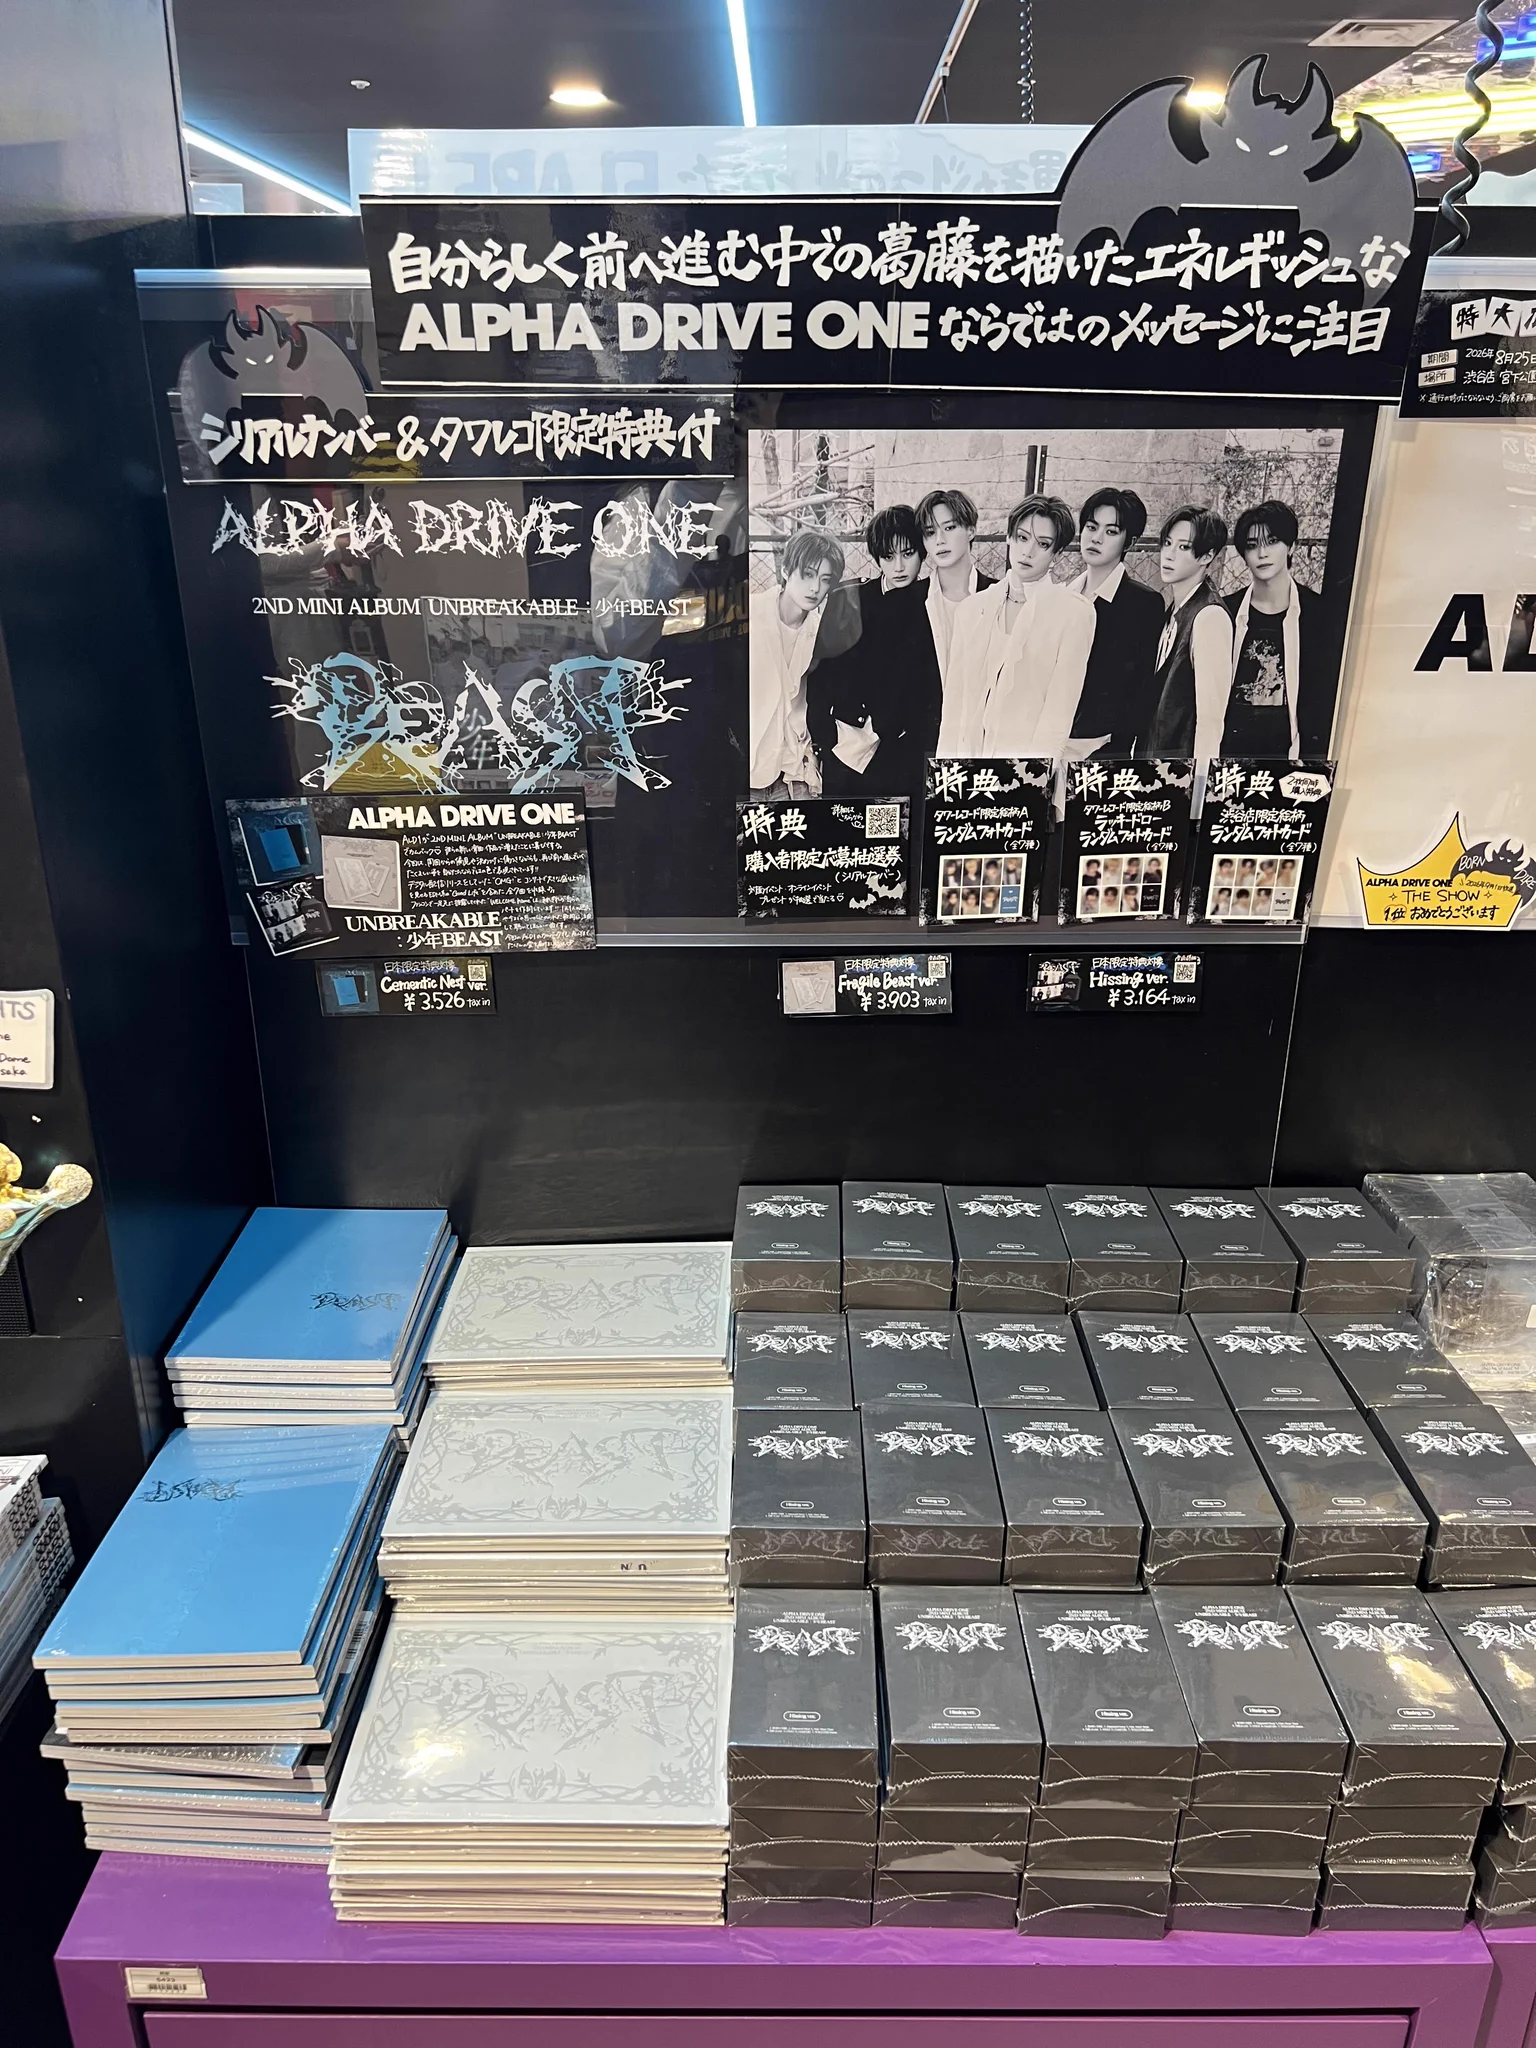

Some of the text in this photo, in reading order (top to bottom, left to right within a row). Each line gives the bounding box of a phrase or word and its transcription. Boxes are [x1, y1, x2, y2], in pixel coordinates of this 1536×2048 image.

[388, 217, 1410, 293] 自分らしく前へ進む中での葛藤を描いたエネルギッシュな
[400, 301, 1391, 357] ALPHA DRIVE ONE ならではのメッセージに注目
[1427, 352, 1449, 364] 期間
[1423, 371, 1447, 383] 場所
[1463, 369, 1495, 384] 渋谷店
[200, 408, 720, 465] シリアルナンバー&タワレコ限定特典付
[210, 496, 724, 560] ALPHA DRIVE ONE
[252, 598, 294, 616] 2ND
[297, 598, 344, 616] MINI
[347, 598, 421, 616] ALBUM
[428, 598, 578, 616] UNBREAKABLE
[595, 598, 691, 619] 少年BEAST
[934, 762, 999, 802] 特典
[1074, 762, 1140, 802] 特典
[1213, 763, 1274, 801] 特典
[348, 803, 575, 829] ALPHA DRIVE ONE
[742, 804, 807, 844] 特典
[1094, 813, 1162, 831] ラッキードロー
[1218, 807, 1305, 823] 渋谷店限定絵柄
[934, 820, 1033, 845] ランダムフォトカード
[1079, 825, 1172, 848] ランダムフォトカード
[1210, 823, 1312, 844] ランダムフォトカード
[745, 845, 903, 873] 購入者限定応募抽選券
[1458, 855, 1486, 872] BORN
[1365, 878, 1453, 887] ALPHA DRIVE ONE
[1401, 890, 1480, 904] THE SHOW
[345, 911, 501, 932] UNBREAKABLE
[1383, 905, 1499, 921] 1位 おめでとうございます
[407, 930, 503, 950] 少年BEAST
[381, 974, 488, 993] Cementic Nest ver.
[838, 971, 939, 996] Fragile Beast ver.
[1089, 971, 1169, 988] Hissing ver.
[467, 998, 480, 1008] tax
[482, 997, 491, 1006] in
[923, 996, 937, 1007] tax
[938, 996, 947, 1005] in
[1171, 994, 1186, 1005] tax
[1187, 994, 1196, 1004] in
